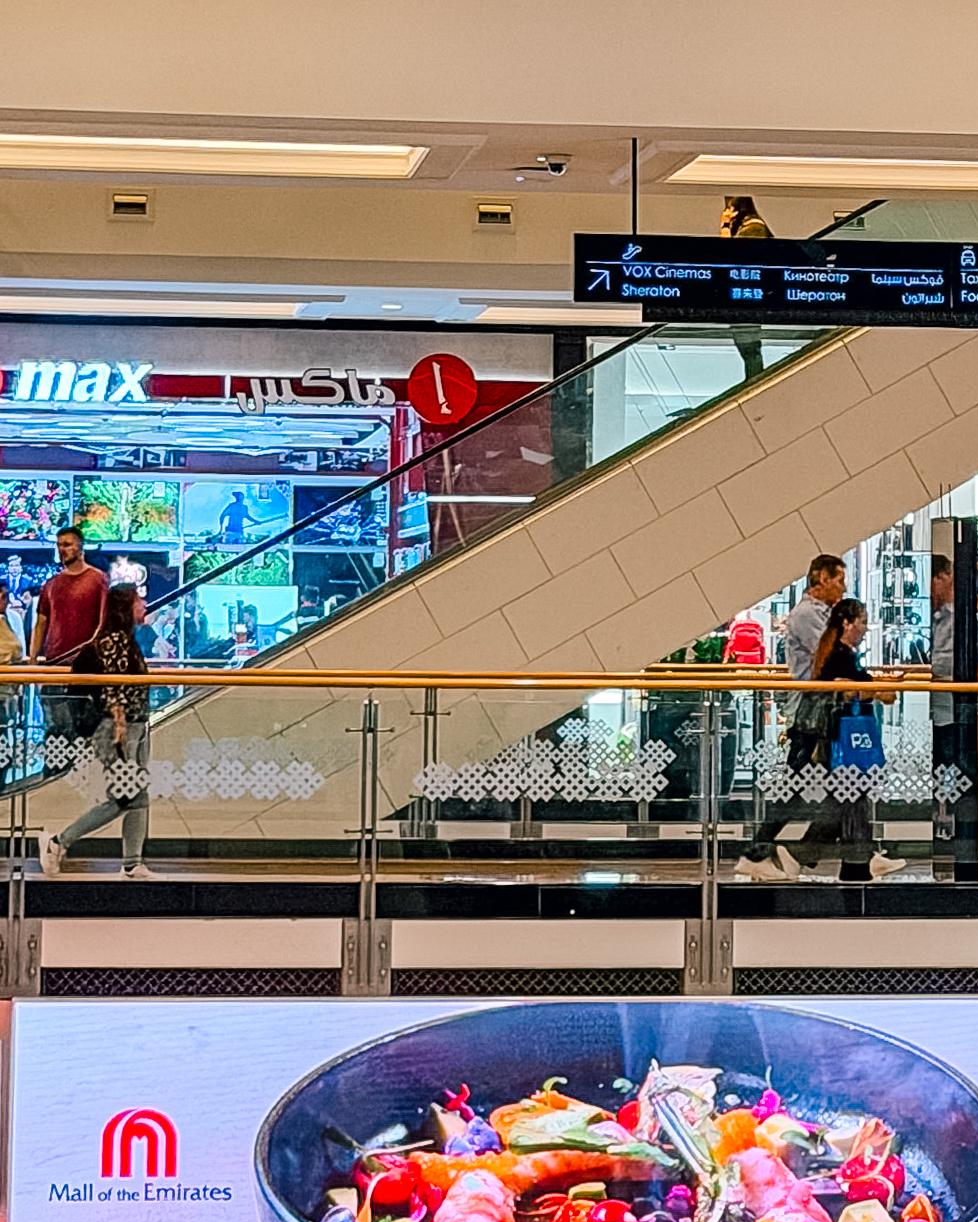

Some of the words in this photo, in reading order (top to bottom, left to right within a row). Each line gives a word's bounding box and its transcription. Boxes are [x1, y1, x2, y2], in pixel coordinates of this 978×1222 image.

[622, 265, 652, 278] VOX
[654, 266, 712, 280] Cinemas
[783, 270, 850, 285] Кинотеатр
[621, 283, 681, 297] Sheraton
[786, 288, 846, 303] Шератон
[14, 360, 154, 402] max
[237, 368, 396, 415] ماكس
[49, 1183, 93, 1202] Mall
[98, 1187, 113, 1202] of
[117, 1188, 140, 1202] the
[144, 1182, 232, 1202] Emirates
